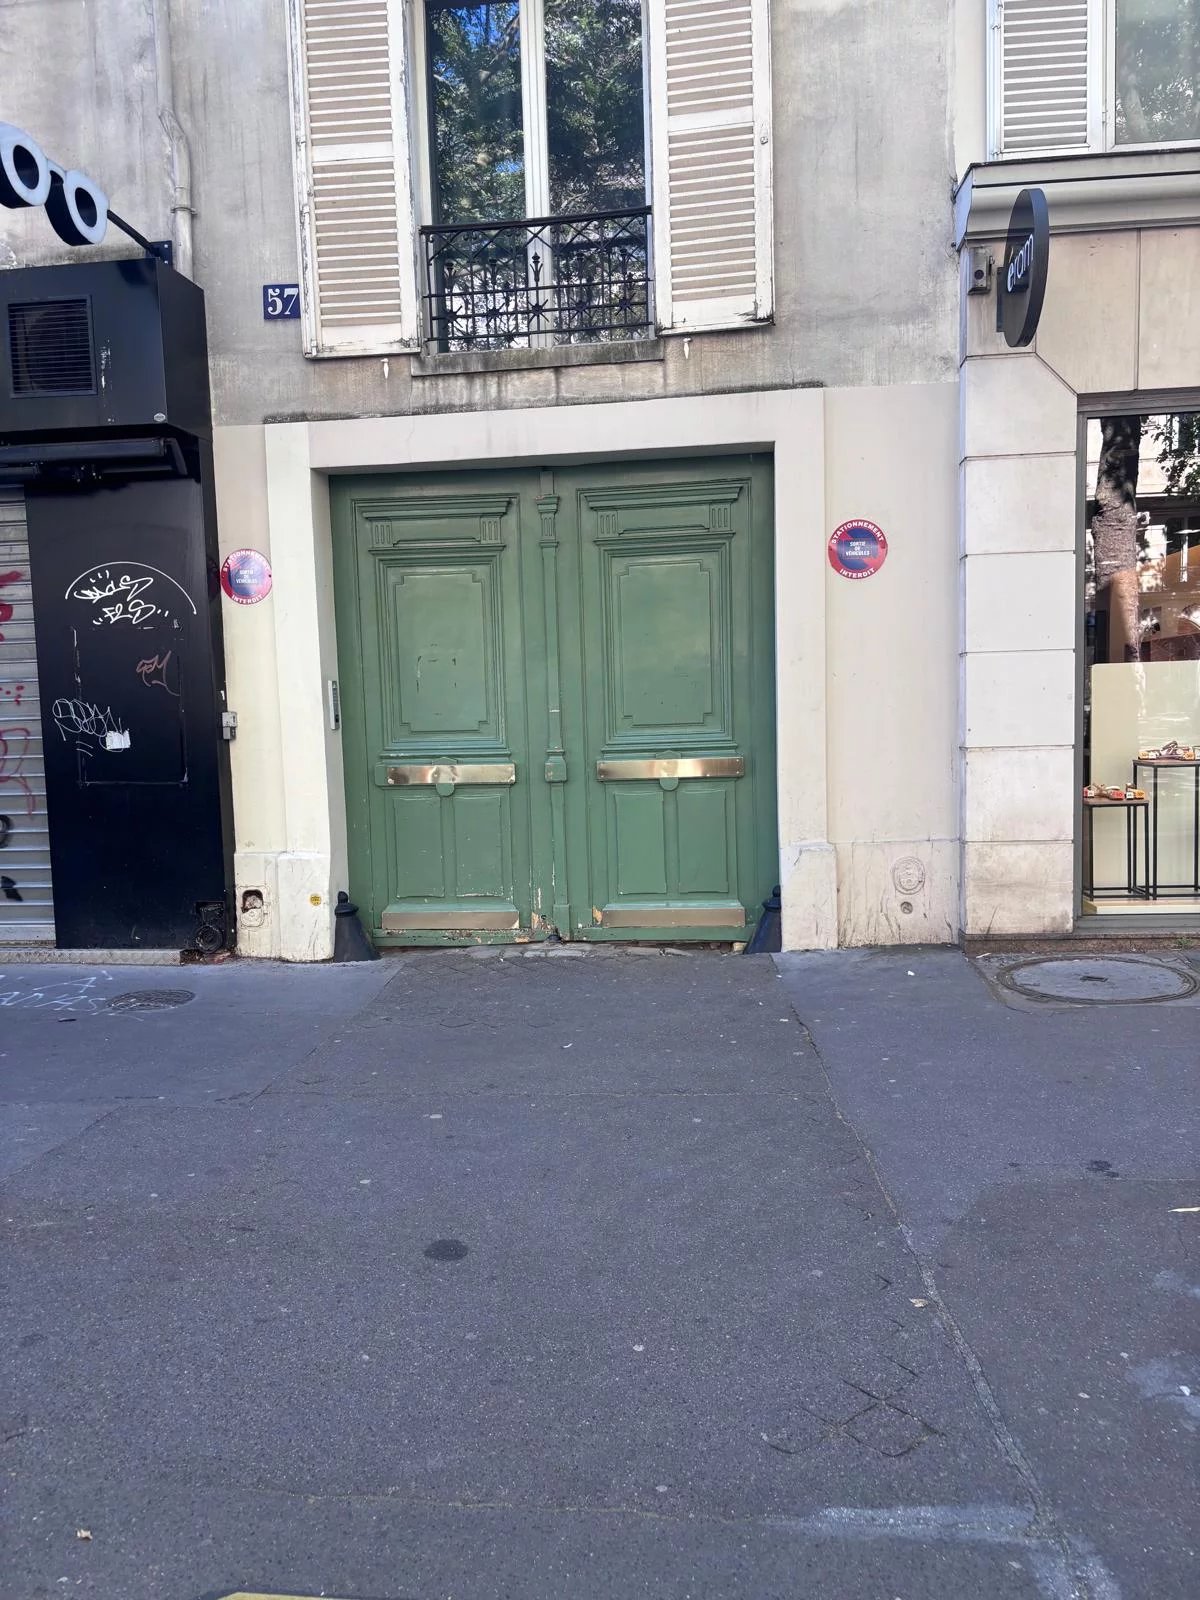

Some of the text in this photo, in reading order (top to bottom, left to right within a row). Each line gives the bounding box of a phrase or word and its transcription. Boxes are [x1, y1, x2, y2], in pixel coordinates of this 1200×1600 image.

[267, 287, 299, 315] 57
[830, 521, 885, 544] STATIONNEMENT
[839, 567, 876, 579] INTERDIT
[231, 594, 263, 604] INTERDIT
